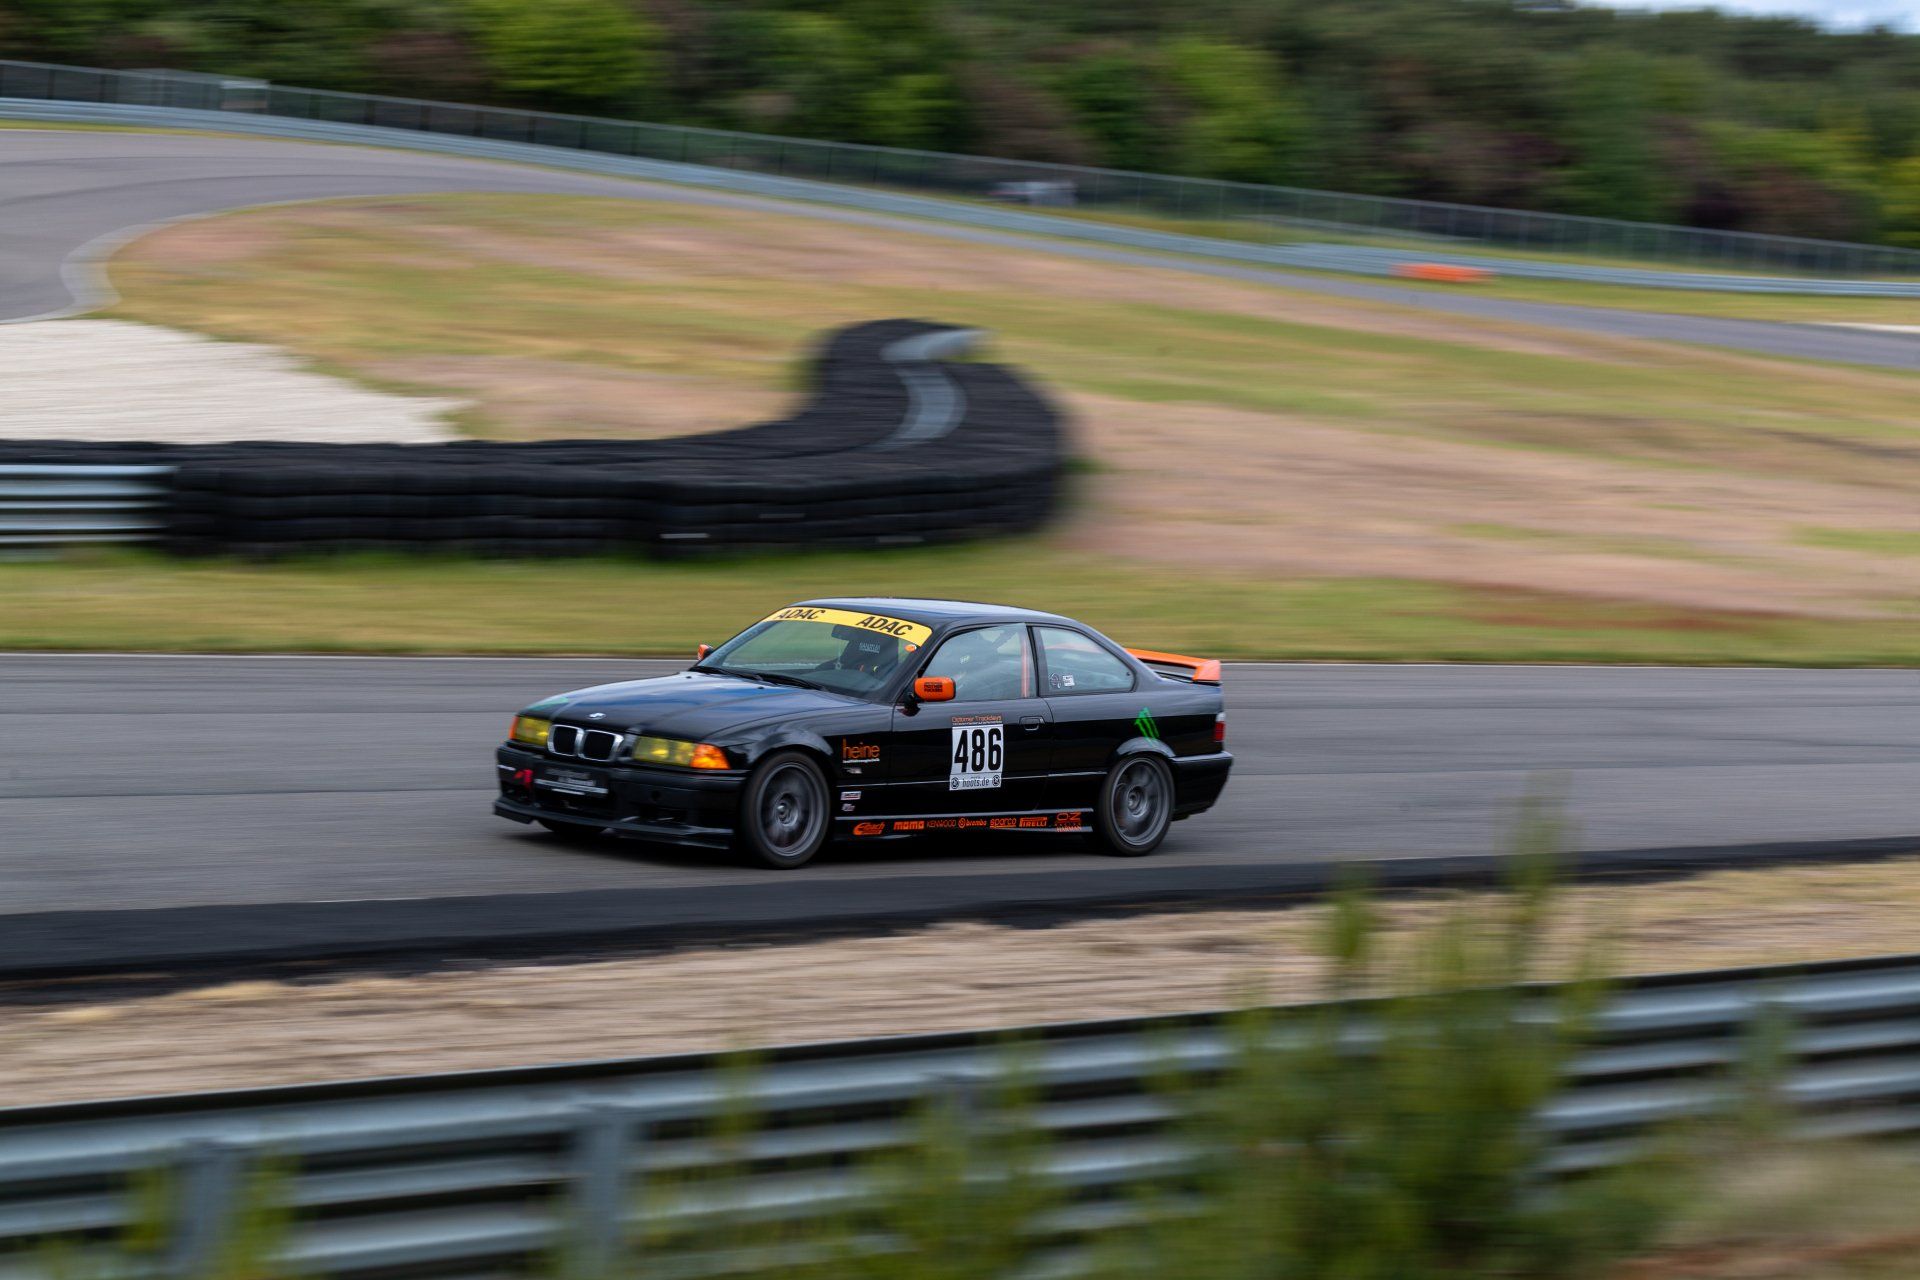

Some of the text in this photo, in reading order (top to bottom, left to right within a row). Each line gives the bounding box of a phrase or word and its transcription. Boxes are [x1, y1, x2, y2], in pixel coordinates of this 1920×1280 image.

[778, 608, 913, 636] ADAC ADAC
[842, 737, 881, 759] heine
[954, 728, 1002, 772] 486
[927, 819, 957, 828] KENWOOD
[966, 819, 987, 827] brembo
[989, 818, 1016, 828] sparco
[1018, 816, 1048, 828] PIRELLI
